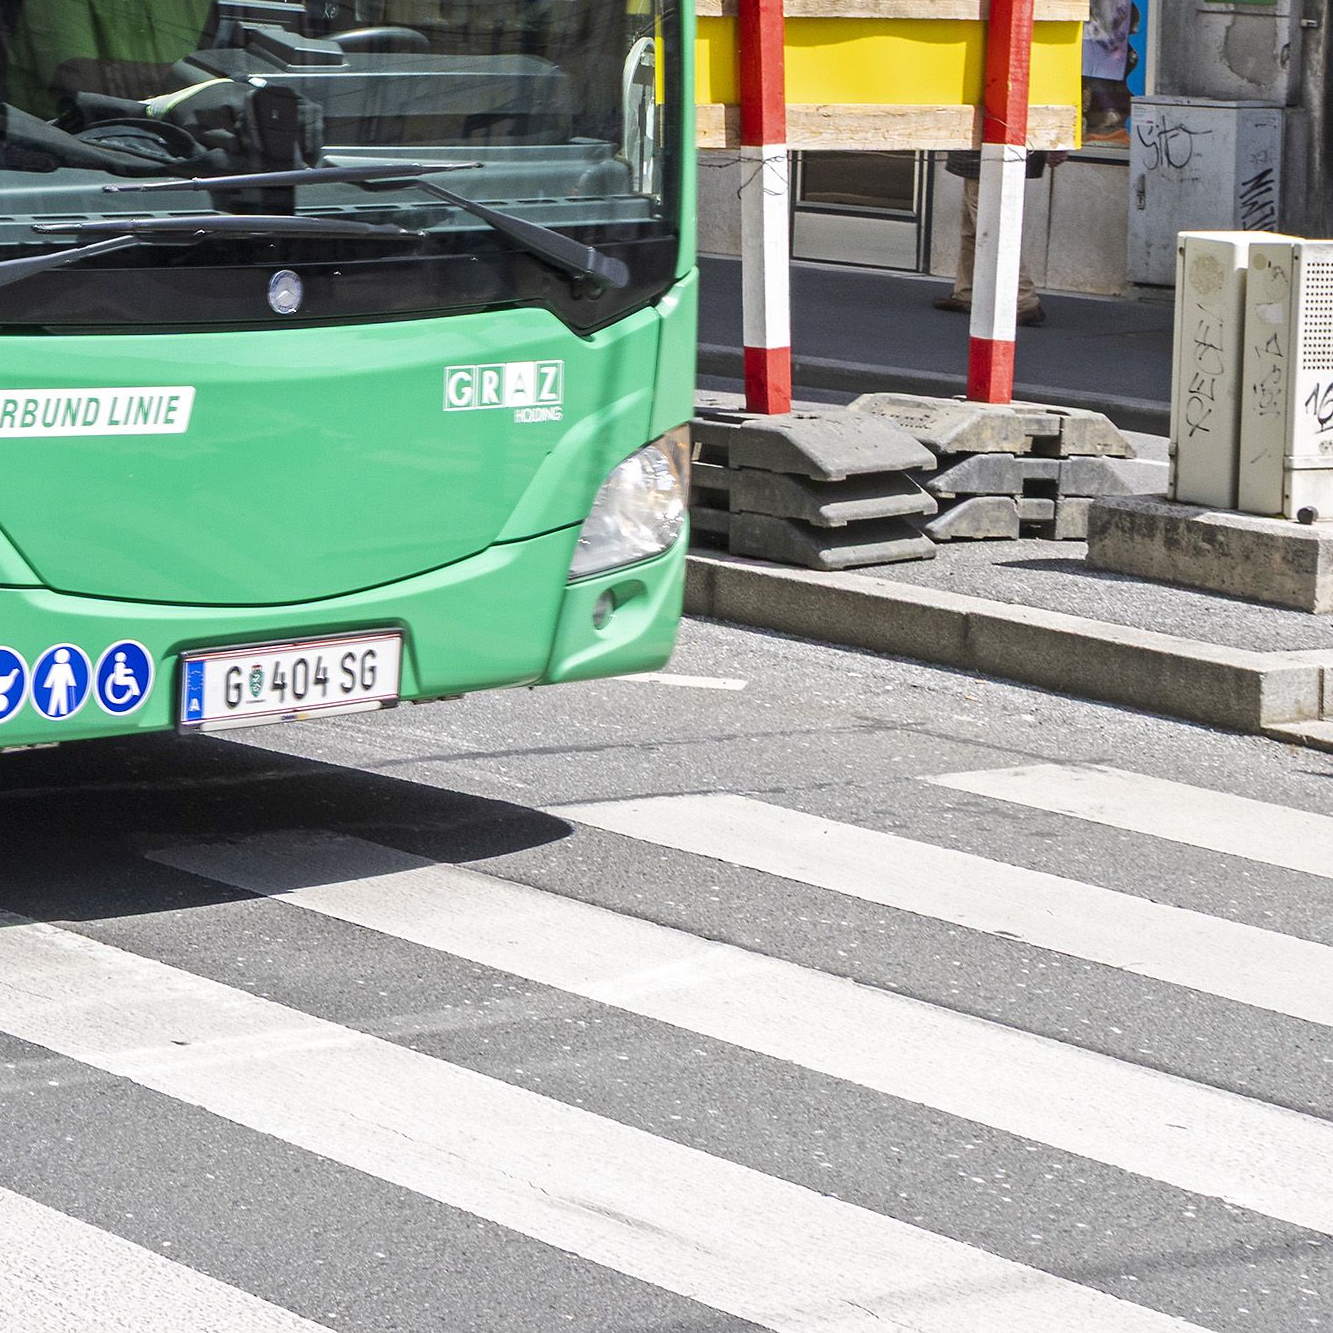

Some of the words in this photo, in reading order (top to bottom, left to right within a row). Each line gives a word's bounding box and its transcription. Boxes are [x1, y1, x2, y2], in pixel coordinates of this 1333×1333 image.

[447, 365, 560, 407] GRAZ
[107, 395, 181, 427] LINIE
[514, 405, 564, 424] HOLDING
[225, 665, 243, 710] G
[269, 655, 329, 704] 404
[340, 648, 378, 694] SG
[189, 697, 201, 712] A
